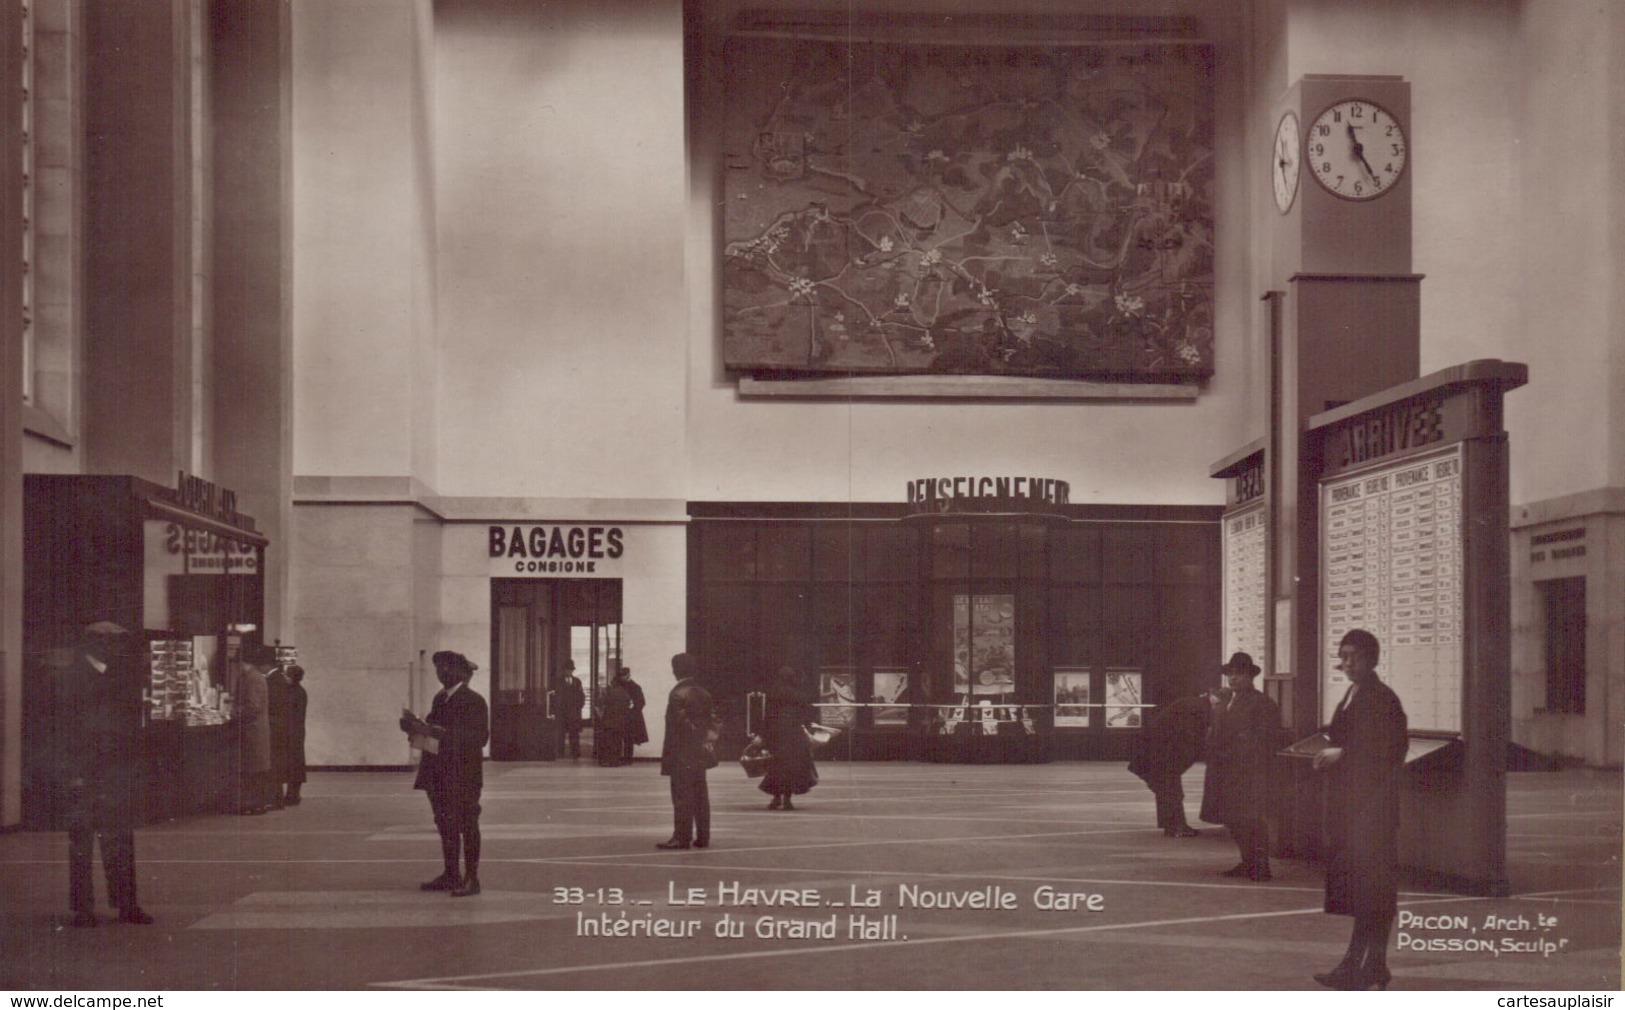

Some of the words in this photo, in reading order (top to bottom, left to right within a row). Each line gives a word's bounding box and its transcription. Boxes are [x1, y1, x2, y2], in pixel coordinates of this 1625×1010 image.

[1334, 111, 1341, 122] 11
[1350, 106, 1363, 118] 12
[1320, 124, 1330, 136] 10
[1385, 125, 1393, 137] 2
[1316, 143, 1324, 156] 9
[1391, 143, 1399, 156] 3
[1322, 162, 1331, 173] 8
[1385, 163, 1393, 172] 4
[1336, 175, 1344, 187] 7
[1354, 180, 1362, 192] 6
[1374, 175, 1381, 187] 5
[489, 526, 624, 559] BAGAGES
[515, 561, 596, 573] CONSIGNE
